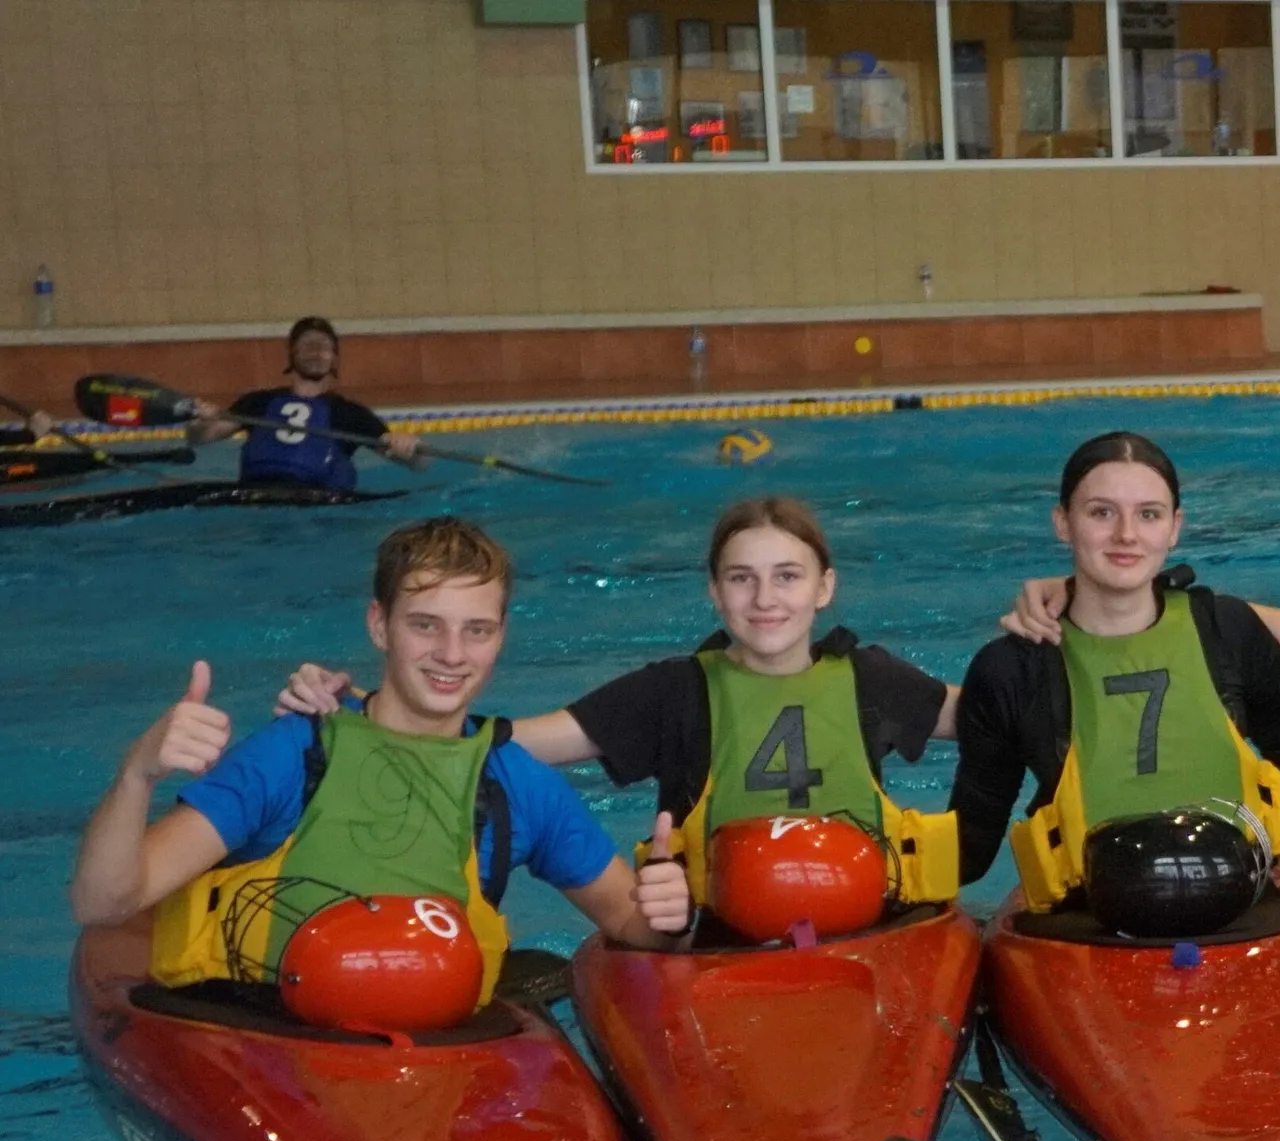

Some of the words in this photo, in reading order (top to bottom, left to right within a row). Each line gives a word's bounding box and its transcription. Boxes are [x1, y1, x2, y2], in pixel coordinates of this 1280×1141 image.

[275, 402, 311, 444] 3
[745, 705, 823, 809] 4
[1102, 668, 1170, 775] 7
